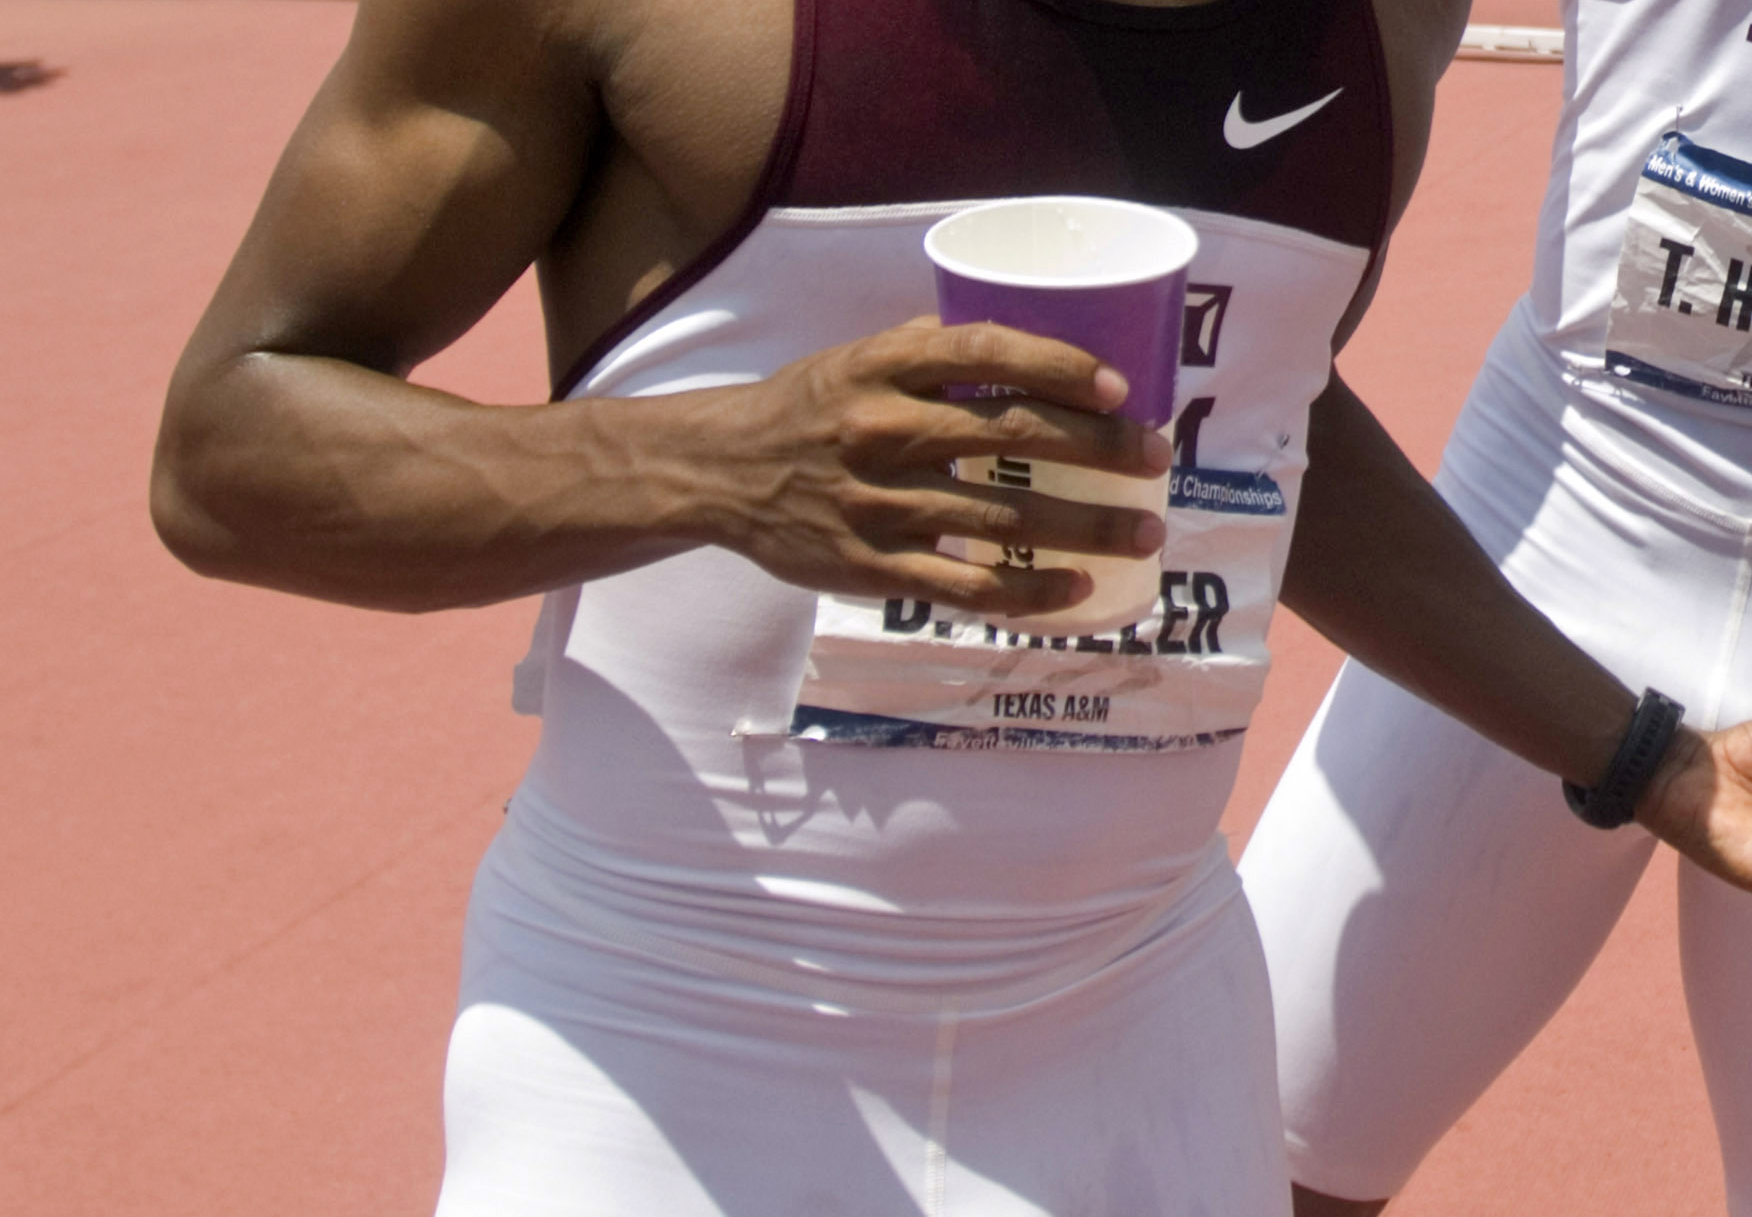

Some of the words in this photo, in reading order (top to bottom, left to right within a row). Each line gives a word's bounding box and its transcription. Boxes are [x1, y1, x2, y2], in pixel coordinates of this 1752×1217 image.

[1646, 156, 1683, 183] Men's
[1685, 172, 1696, 188] &
[1658, 238, 1694, 314] T.
[1182, 479, 1282, 507] Championships
[993, 691, 1056, 720] TEXAS
[1061, 694, 1110, 722] A&M
